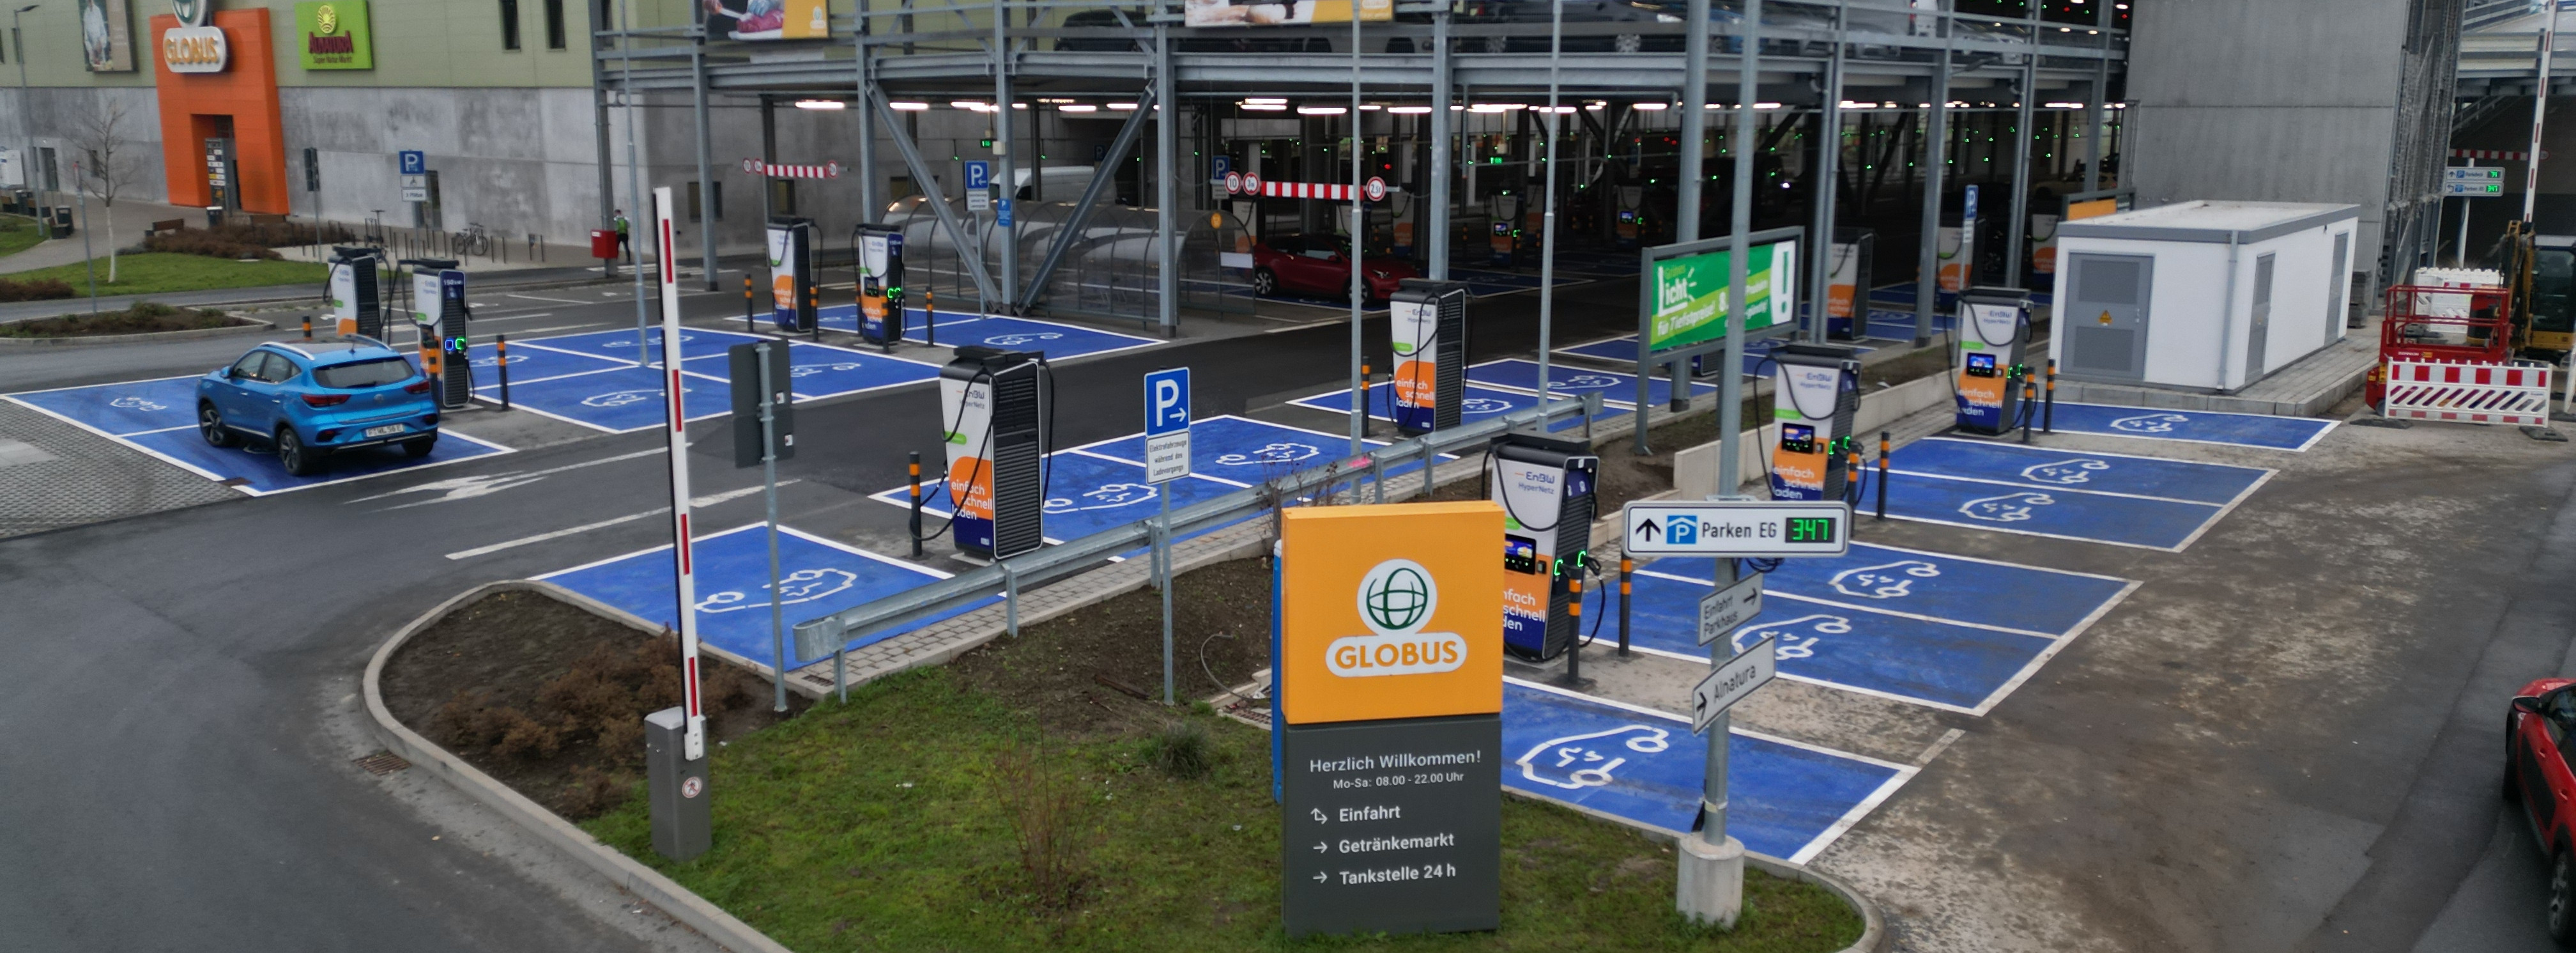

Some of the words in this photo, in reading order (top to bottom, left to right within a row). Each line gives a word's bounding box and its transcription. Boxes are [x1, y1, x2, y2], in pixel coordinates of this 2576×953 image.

[164, 38, 218, 63] GLOBUS
[405, 153, 418, 172] P
[1216, 159, 1225, 178] P
[970, 164, 983, 187] P
[1229, 179, 1238, 188] 10
[1156, 378, 1179, 428] P
[1518, 482, 1554, 495] HyperNetz
[1526, 471, 1555, 484] EnBW
[1702, 522, 1752, 538] Parken
[1759, 522, 1777, 538] EG
[1792, 519, 1829, 541] 347
[1704, 596, 1733, 620] Einfahrt
[1703, 610, 1738, 638] Parkhaus
[1335, 640, 1459, 669] GLOBUS
[1713, 665, 1756, 704] Alnatura
[1310, 755, 1374, 773] Herzlich
[1379, 749, 1481, 769] Willkommen!
[1333, 777, 1372, 789] Mo-Sa:
[1376, 775, 1406, 787] 08.00
[1414, 773, 1444, 784] 22.00
[1446, 771, 1464, 782] Uhr
[1339, 805, 1401, 823] Einfahrt
[1338, 832, 1455, 854] Getränkemarkt
[1339, 866, 1420, 885] Tankstelle
[1423, 864, 1443, 879] 24
[1446, 863, 1457, 877] h
